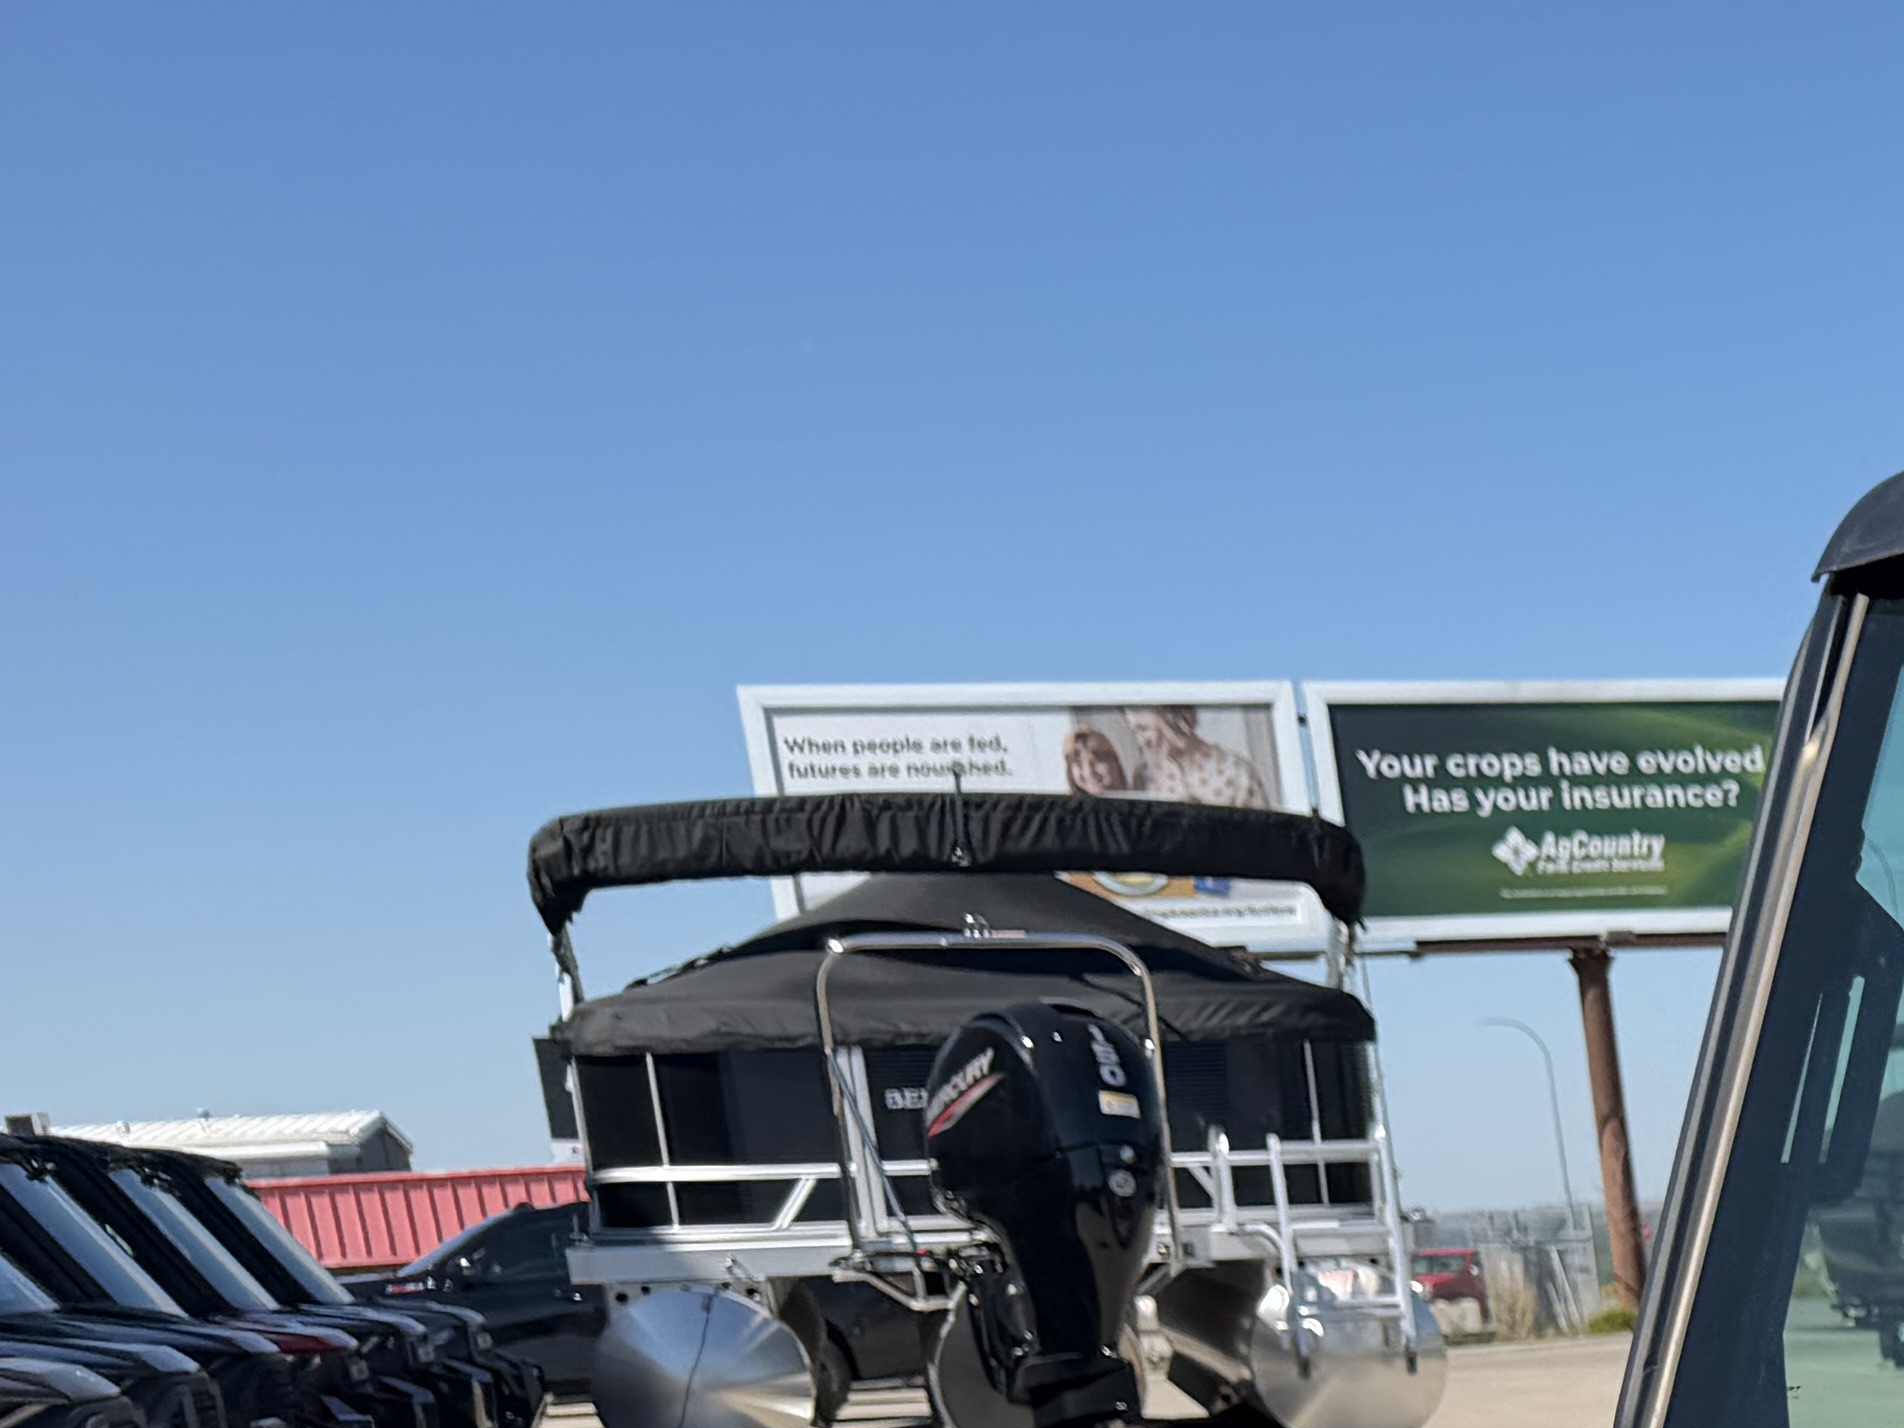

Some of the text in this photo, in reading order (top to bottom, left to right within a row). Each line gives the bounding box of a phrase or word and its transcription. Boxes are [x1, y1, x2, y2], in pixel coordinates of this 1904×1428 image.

[783, 734, 1008, 756] When people are fed,
[788, 759, 1013, 779] futures are nourhed.
[1356, 744, 1766, 782] Your crops have evolved
[1403, 779, 1740, 818] Has your insurance?
[1539, 829, 1665, 862] AgCountry
